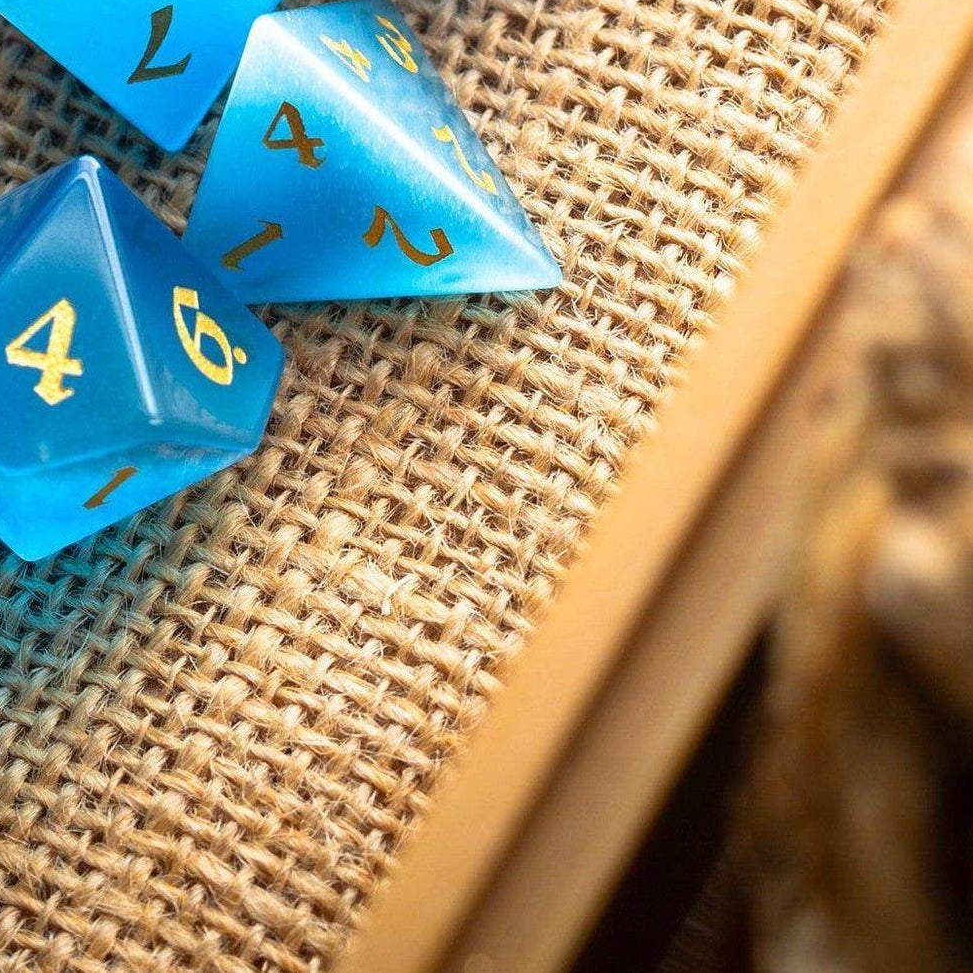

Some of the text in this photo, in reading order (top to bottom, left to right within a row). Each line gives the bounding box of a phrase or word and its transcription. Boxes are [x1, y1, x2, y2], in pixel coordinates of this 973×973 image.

[127, 4, 192, 85] 7
[262, 101, 326, 170] 4
[221, 220, 283, 271] 1
[362, 205, 454, 267] 2
[5, 297, 84, 406] 4
[83, 466, 139, 510] 1
